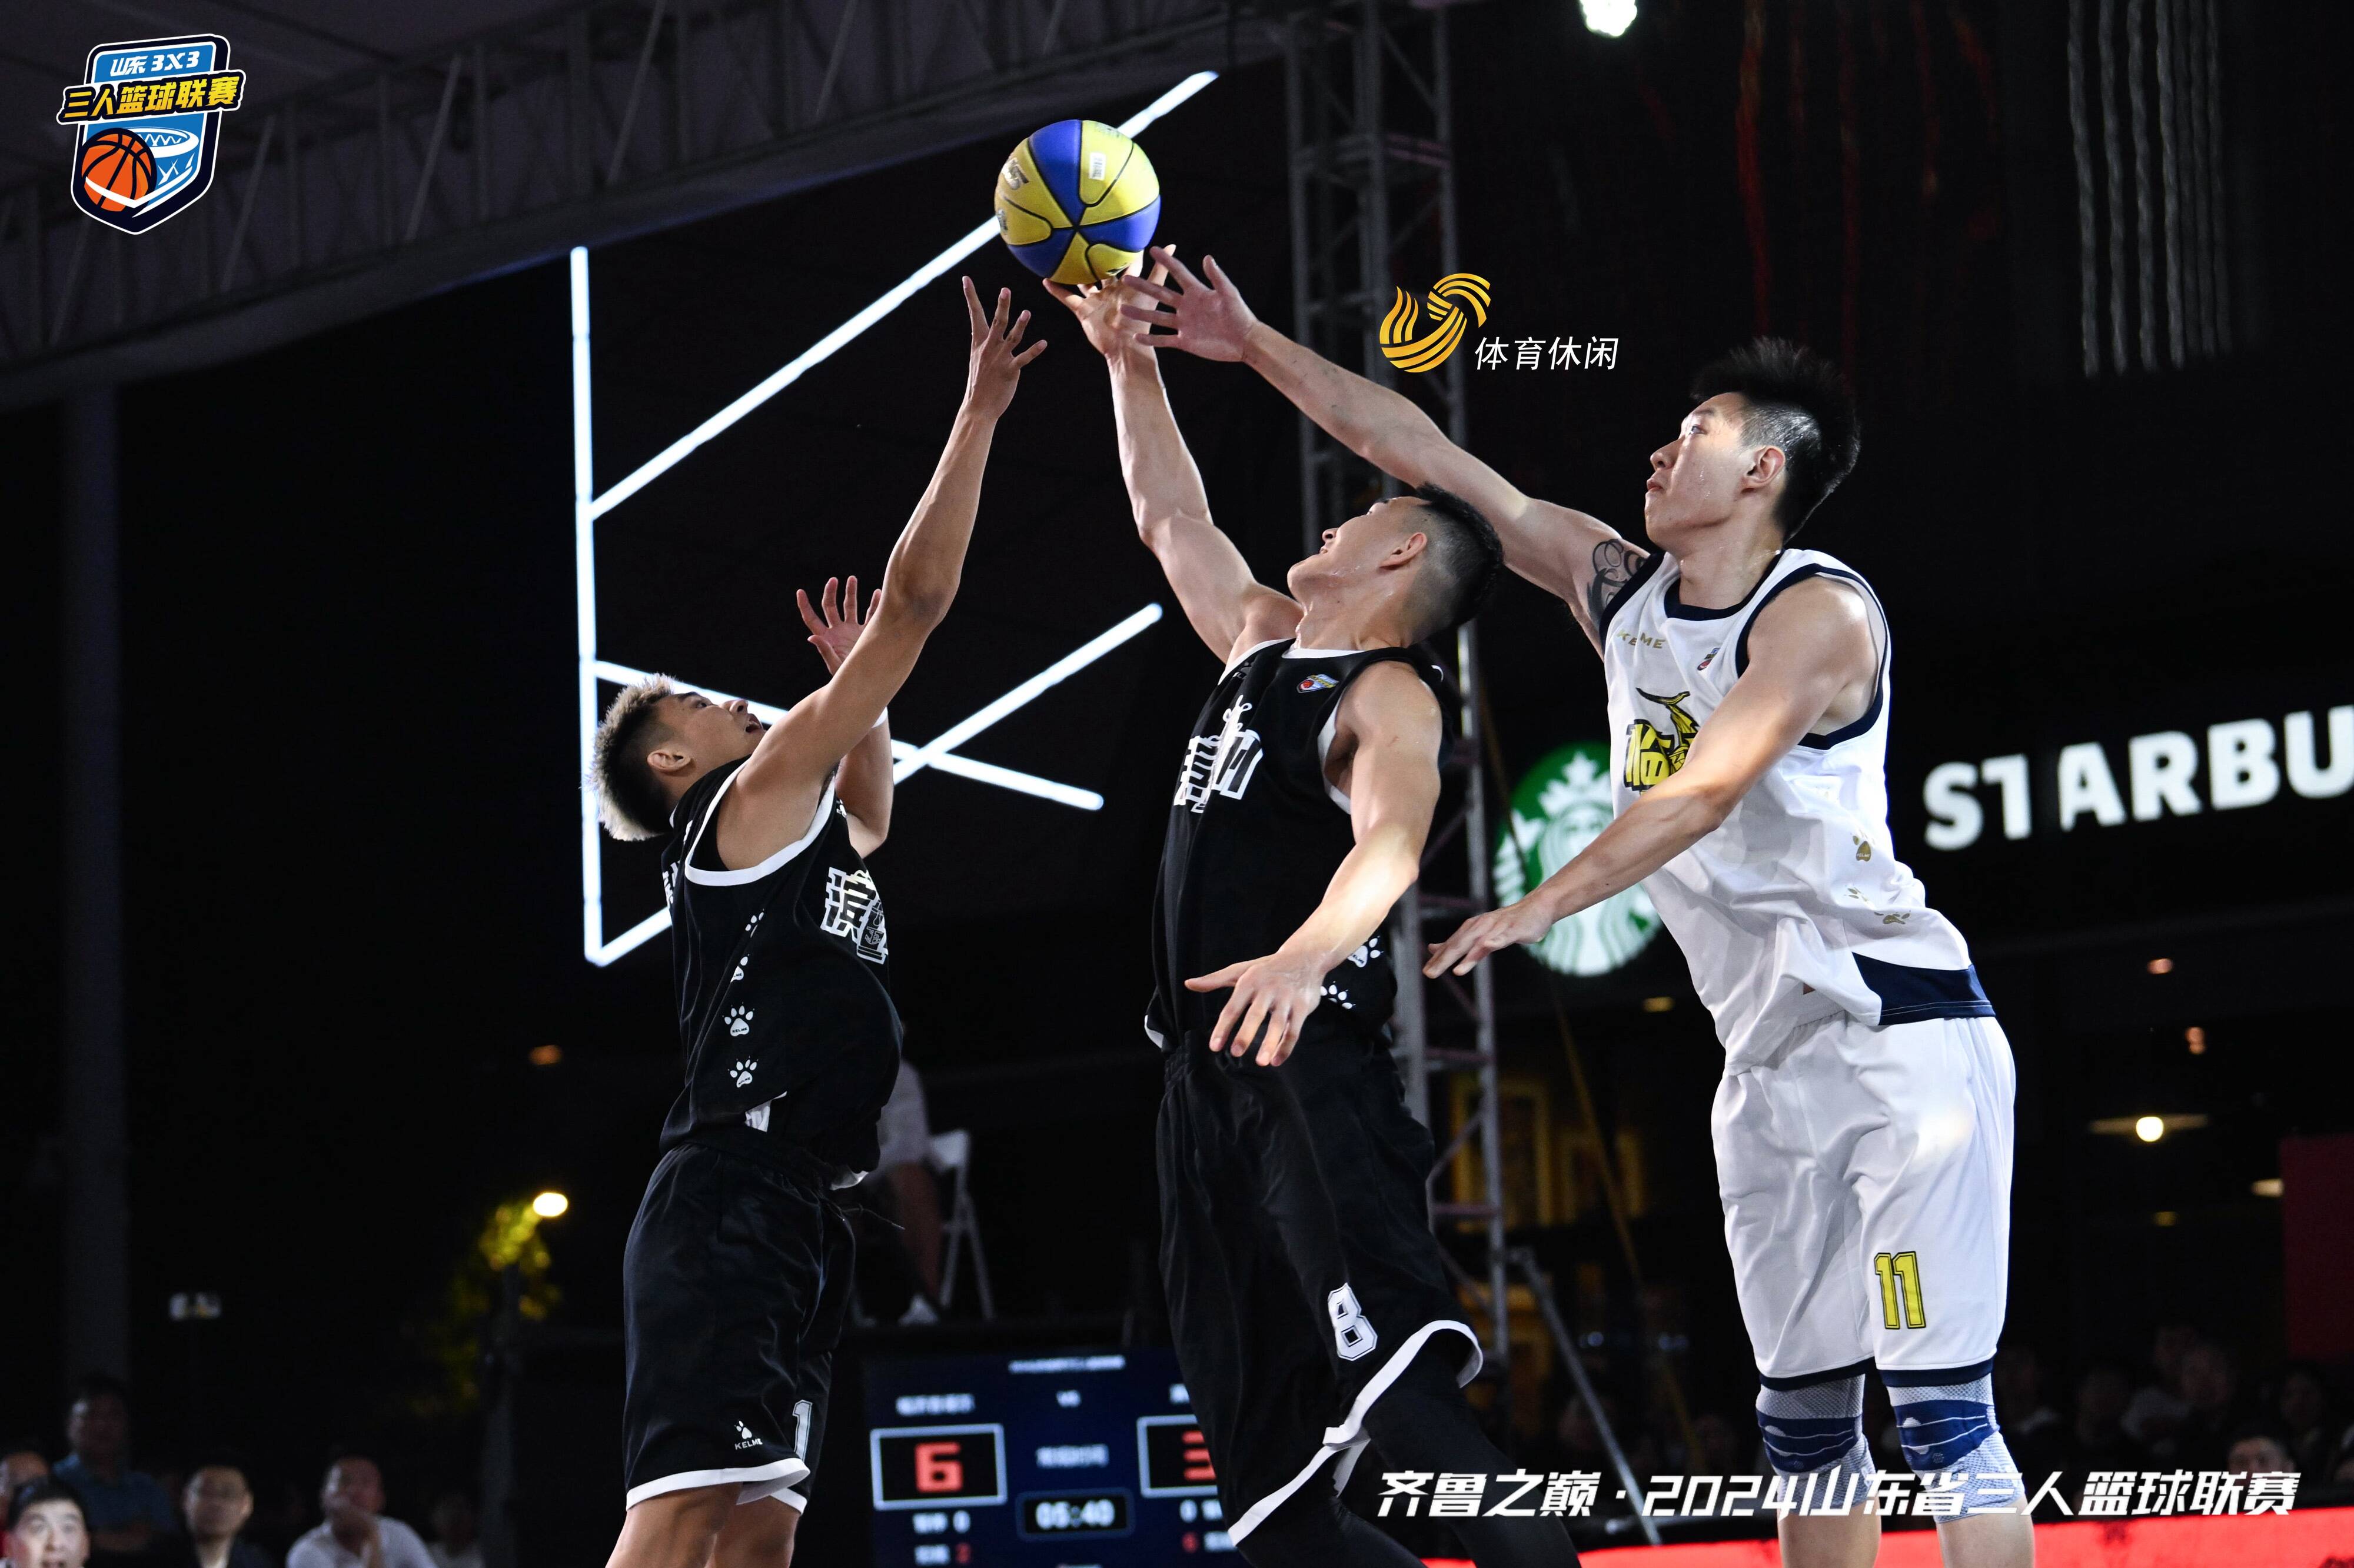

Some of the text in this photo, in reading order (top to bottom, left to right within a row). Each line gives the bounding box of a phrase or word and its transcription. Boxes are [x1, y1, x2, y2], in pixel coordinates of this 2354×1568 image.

[1617, 631, 1665, 648] KEME
[1874, 1251, 1926, 1329] 11
[1327, 1282, 1378, 1361] 8
[734, 1438, 763, 1450] KELME
[914, 1442, 963, 1493] 6
